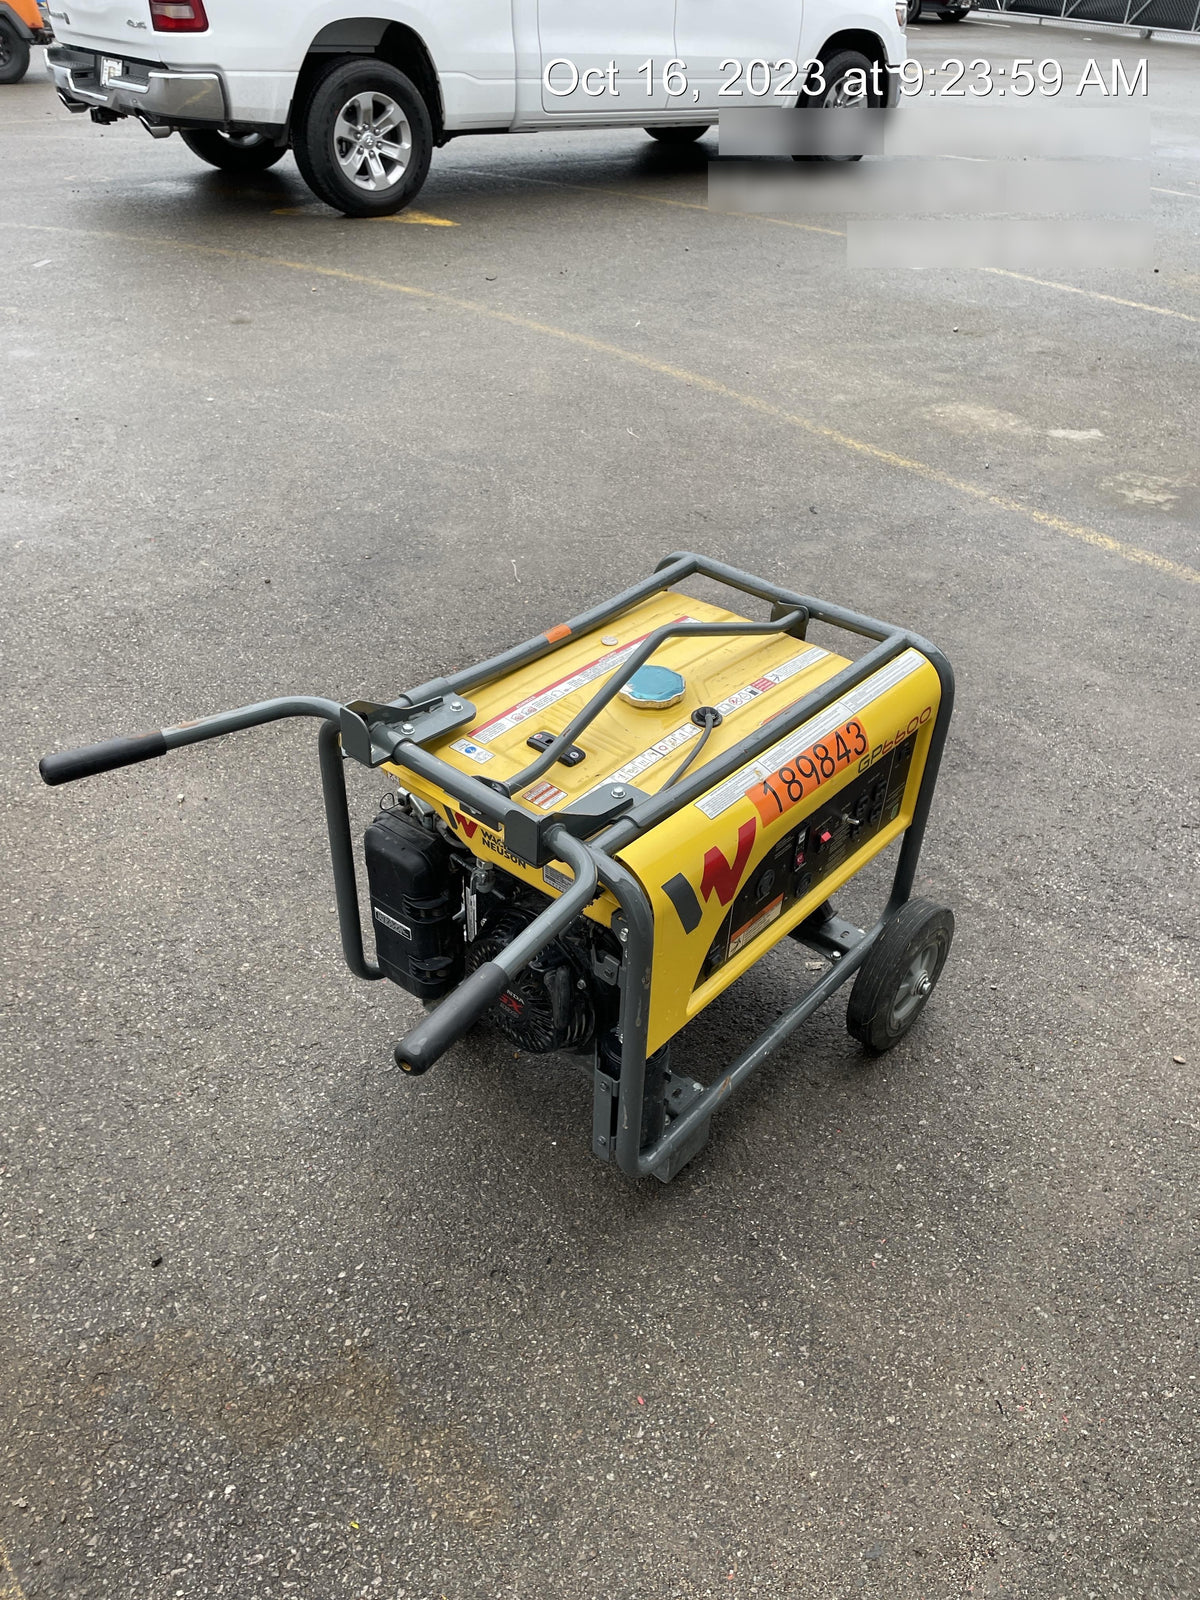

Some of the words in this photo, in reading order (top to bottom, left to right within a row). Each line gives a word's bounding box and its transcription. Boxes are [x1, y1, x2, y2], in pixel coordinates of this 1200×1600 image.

[763, 721, 867, 813] 189843
[857, 706, 932, 774] GP6600
[482, 837, 527, 870] NEUSON
